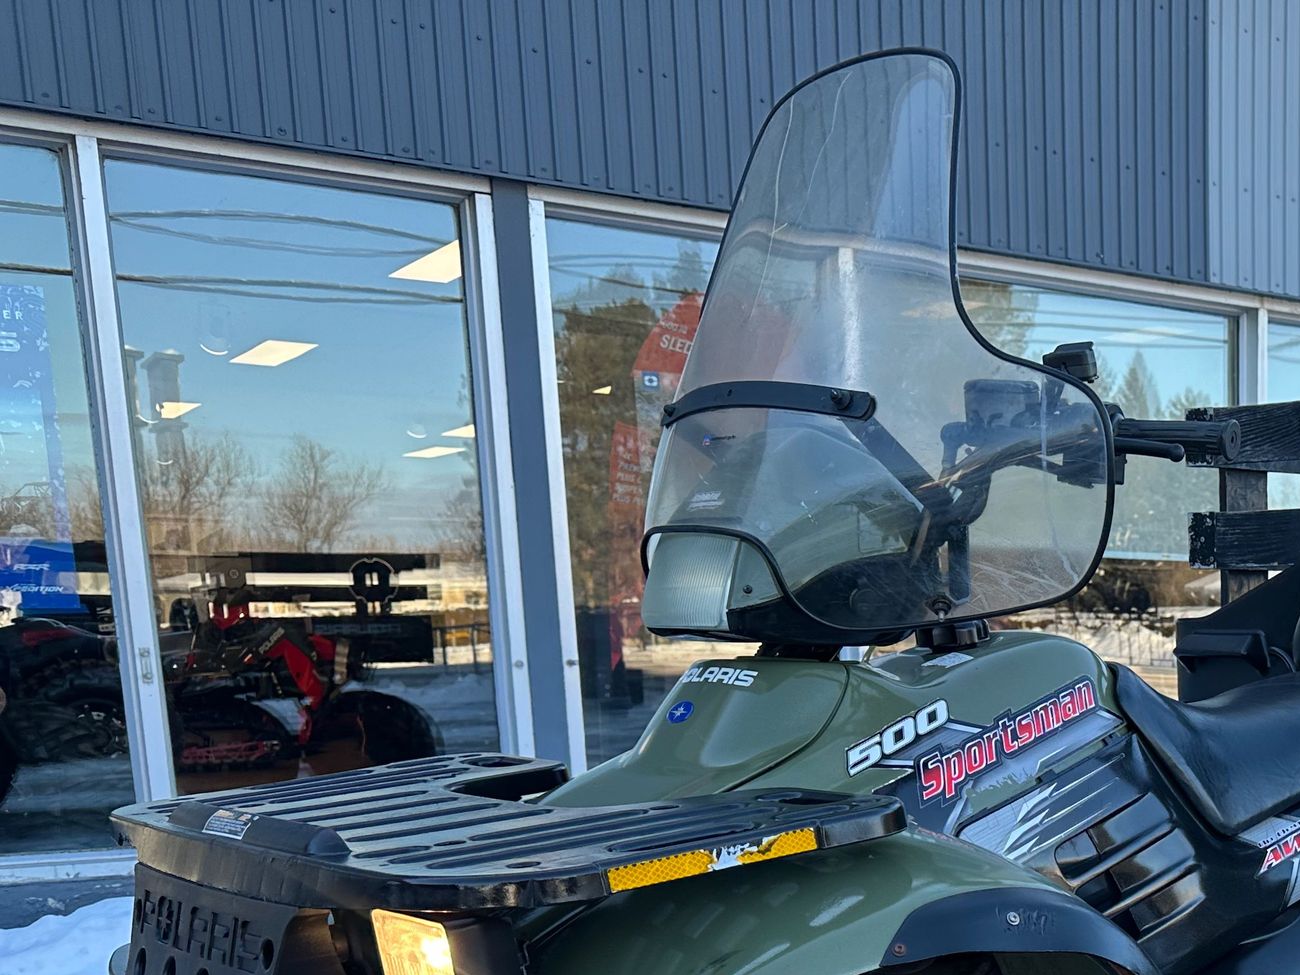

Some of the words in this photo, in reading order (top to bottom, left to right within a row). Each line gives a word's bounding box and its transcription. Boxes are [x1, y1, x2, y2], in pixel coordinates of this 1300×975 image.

[682, 666, 759, 687] OLARIS
[848, 699, 949, 777] 500
[919, 680, 1096, 801] Sportsman
[139, 889, 265, 974] POLARIS
